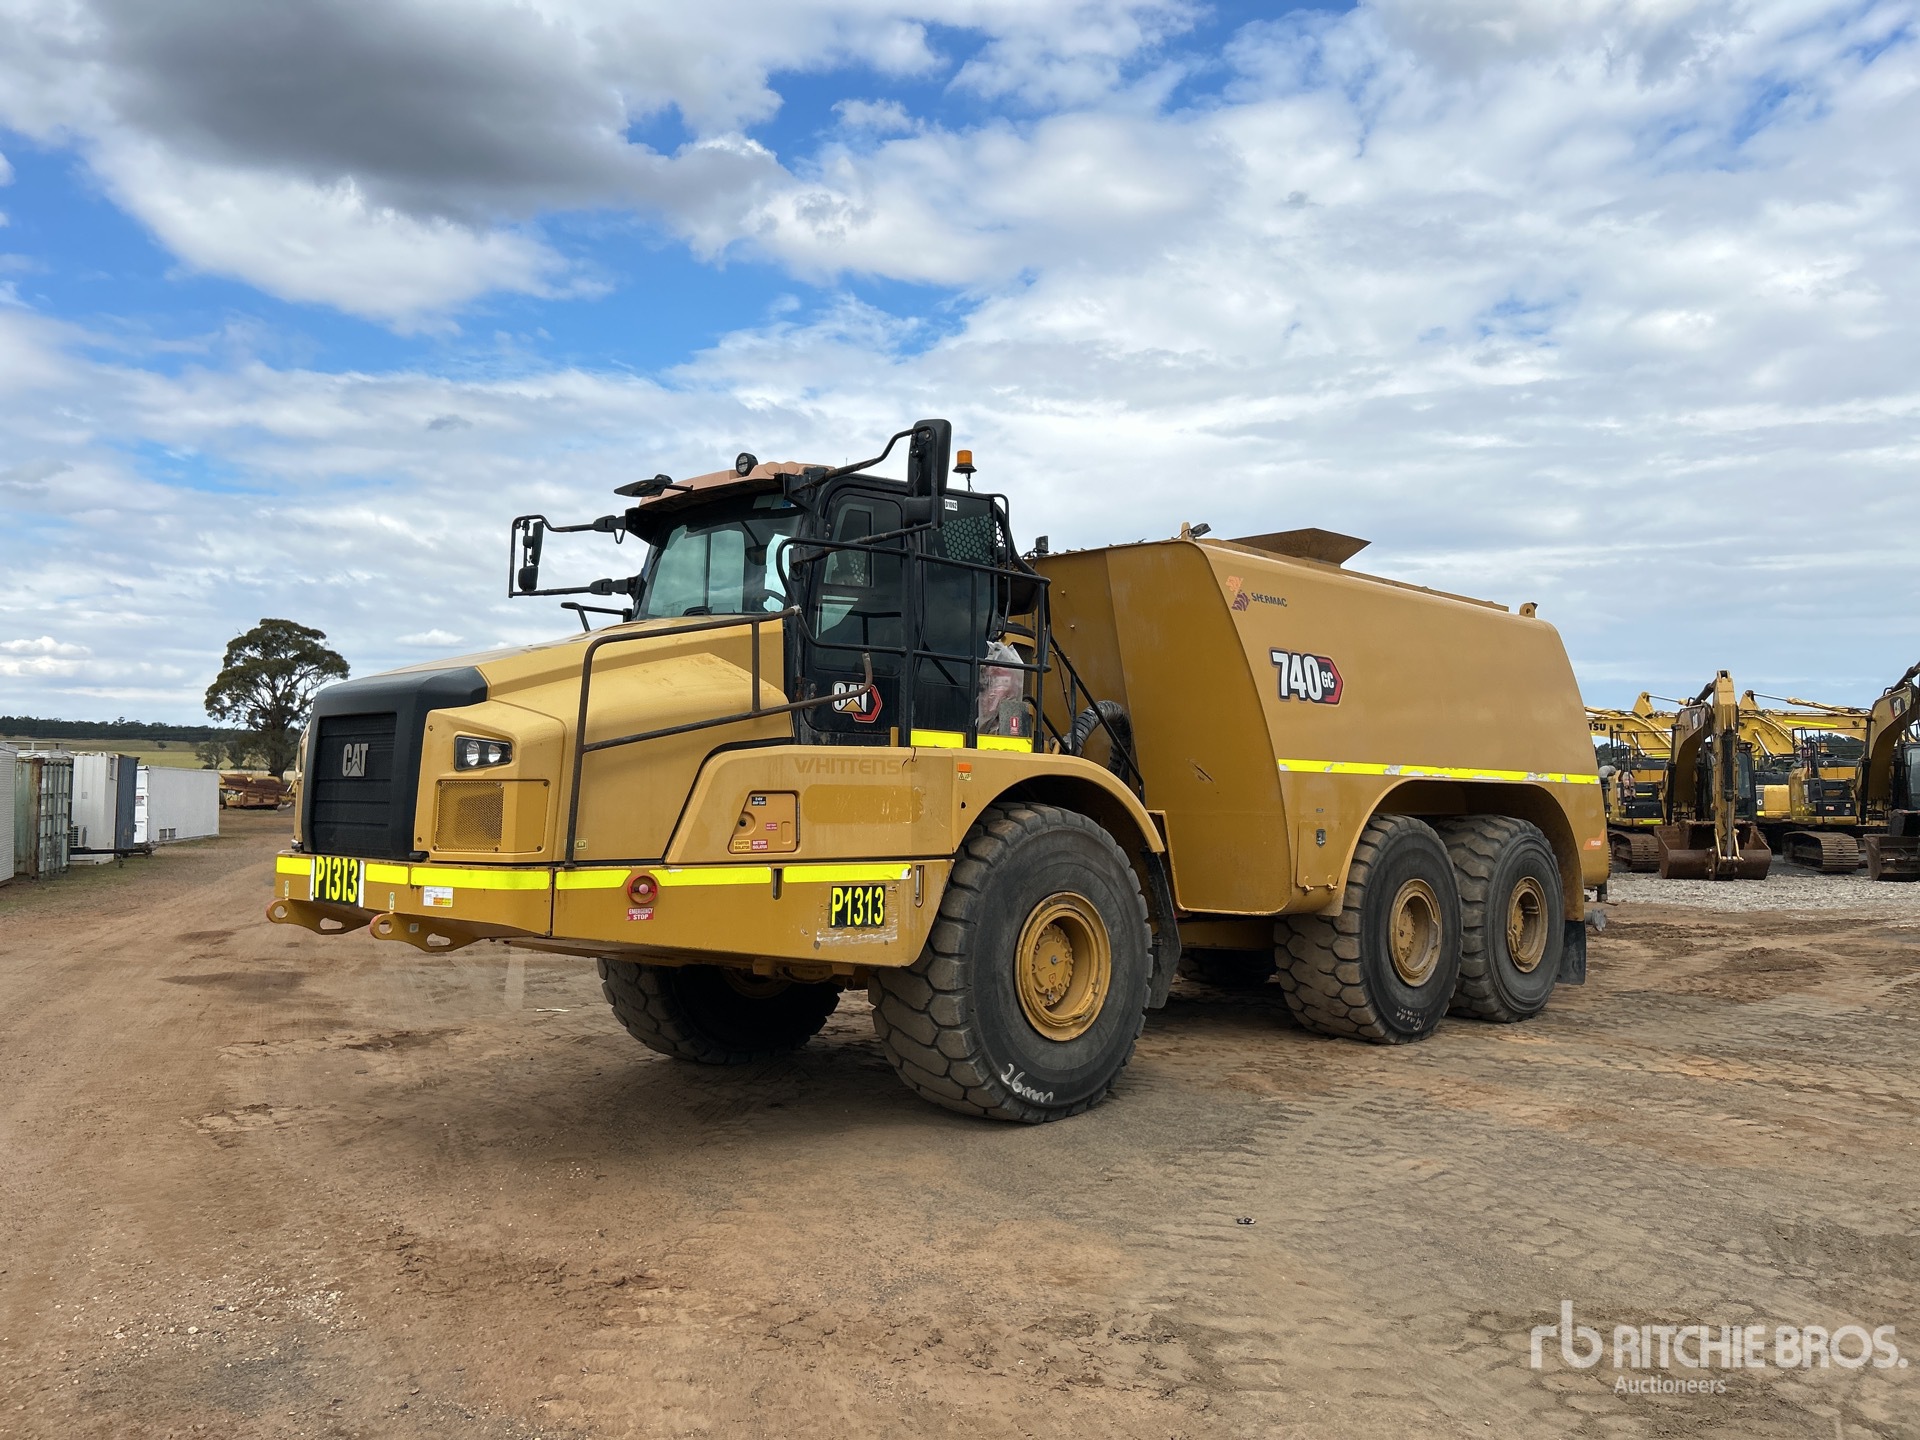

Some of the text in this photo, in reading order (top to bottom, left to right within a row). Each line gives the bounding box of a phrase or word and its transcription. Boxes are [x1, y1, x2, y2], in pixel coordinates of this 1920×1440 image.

[1250, 592, 1288, 608] SHERMAC
[1271, 651, 1335, 701] 740 GC
[342, 743, 369, 777] CAT
[793, 757, 901, 775] WHITTENS
[314, 855, 358, 903] P1313
[628, 907, 654, 915] EMERGENCY
[831, 886, 884, 926] P1313
